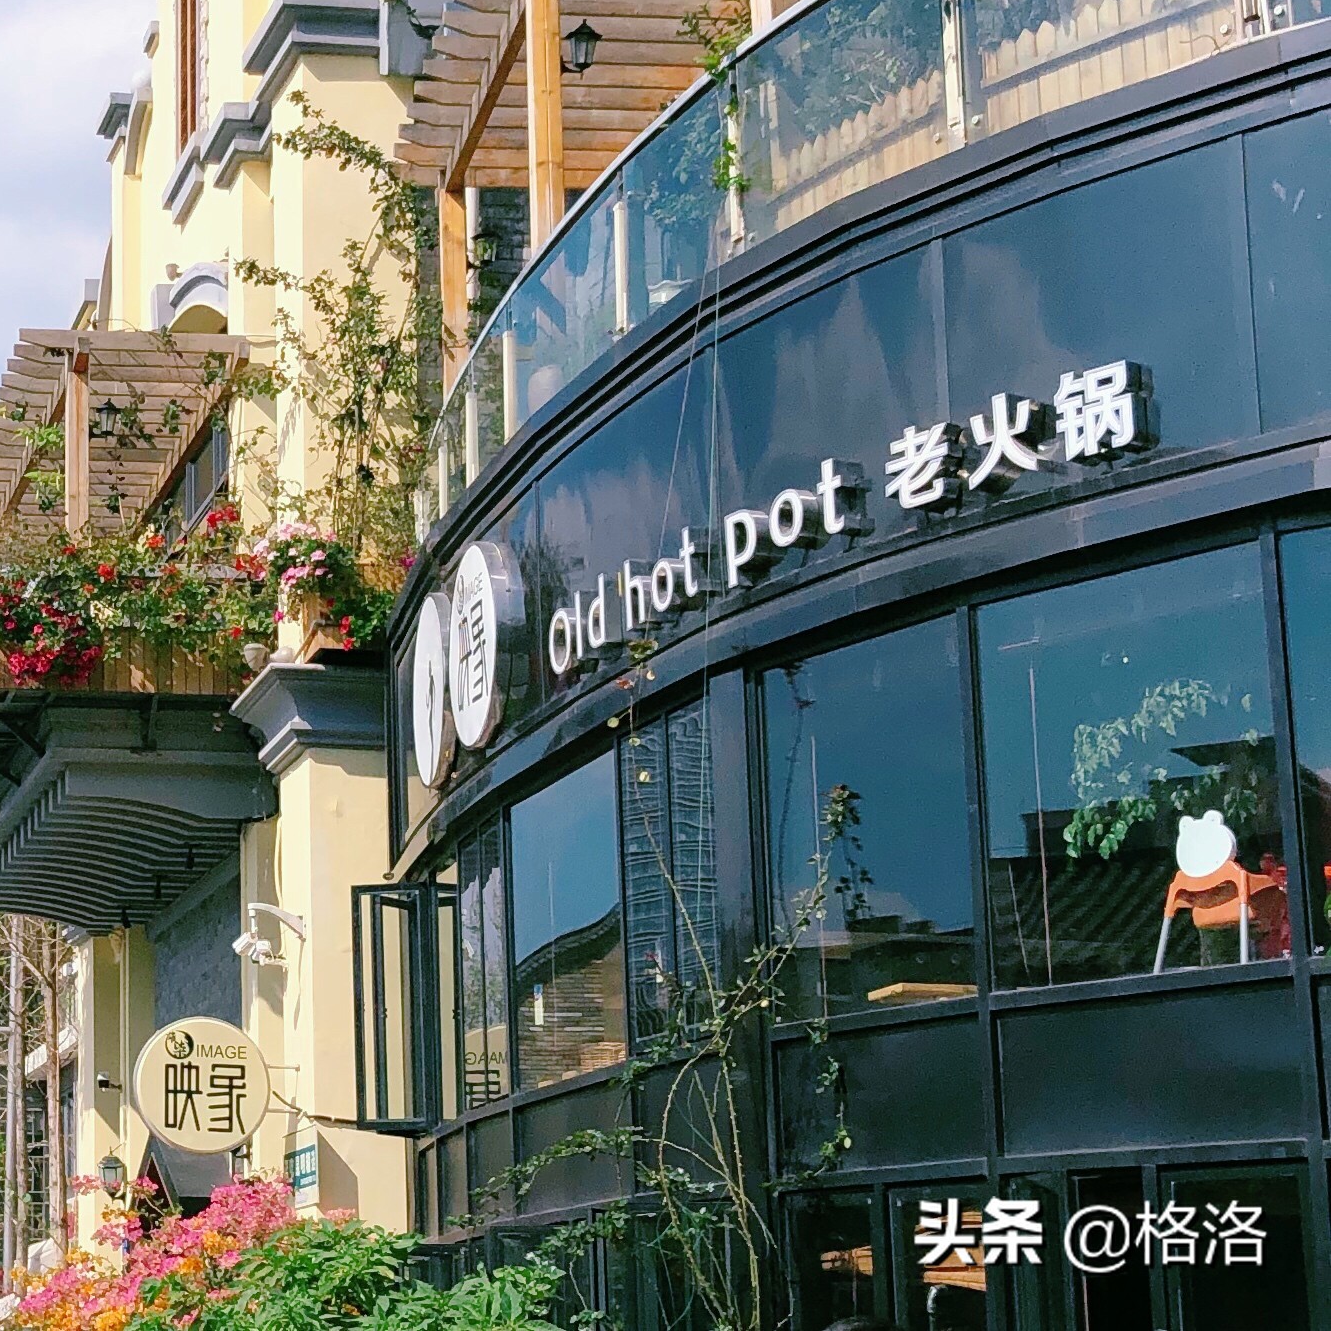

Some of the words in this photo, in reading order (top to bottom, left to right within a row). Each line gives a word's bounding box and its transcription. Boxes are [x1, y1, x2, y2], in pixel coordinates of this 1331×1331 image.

[549, 573, 606, 675] Old
[624, 526, 698, 632] hot
[885, 360, 1136, 509] 老火锅
[196, 1044, 247, 1060] IMAGE
[164, 1061, 247, 1135] 映象
